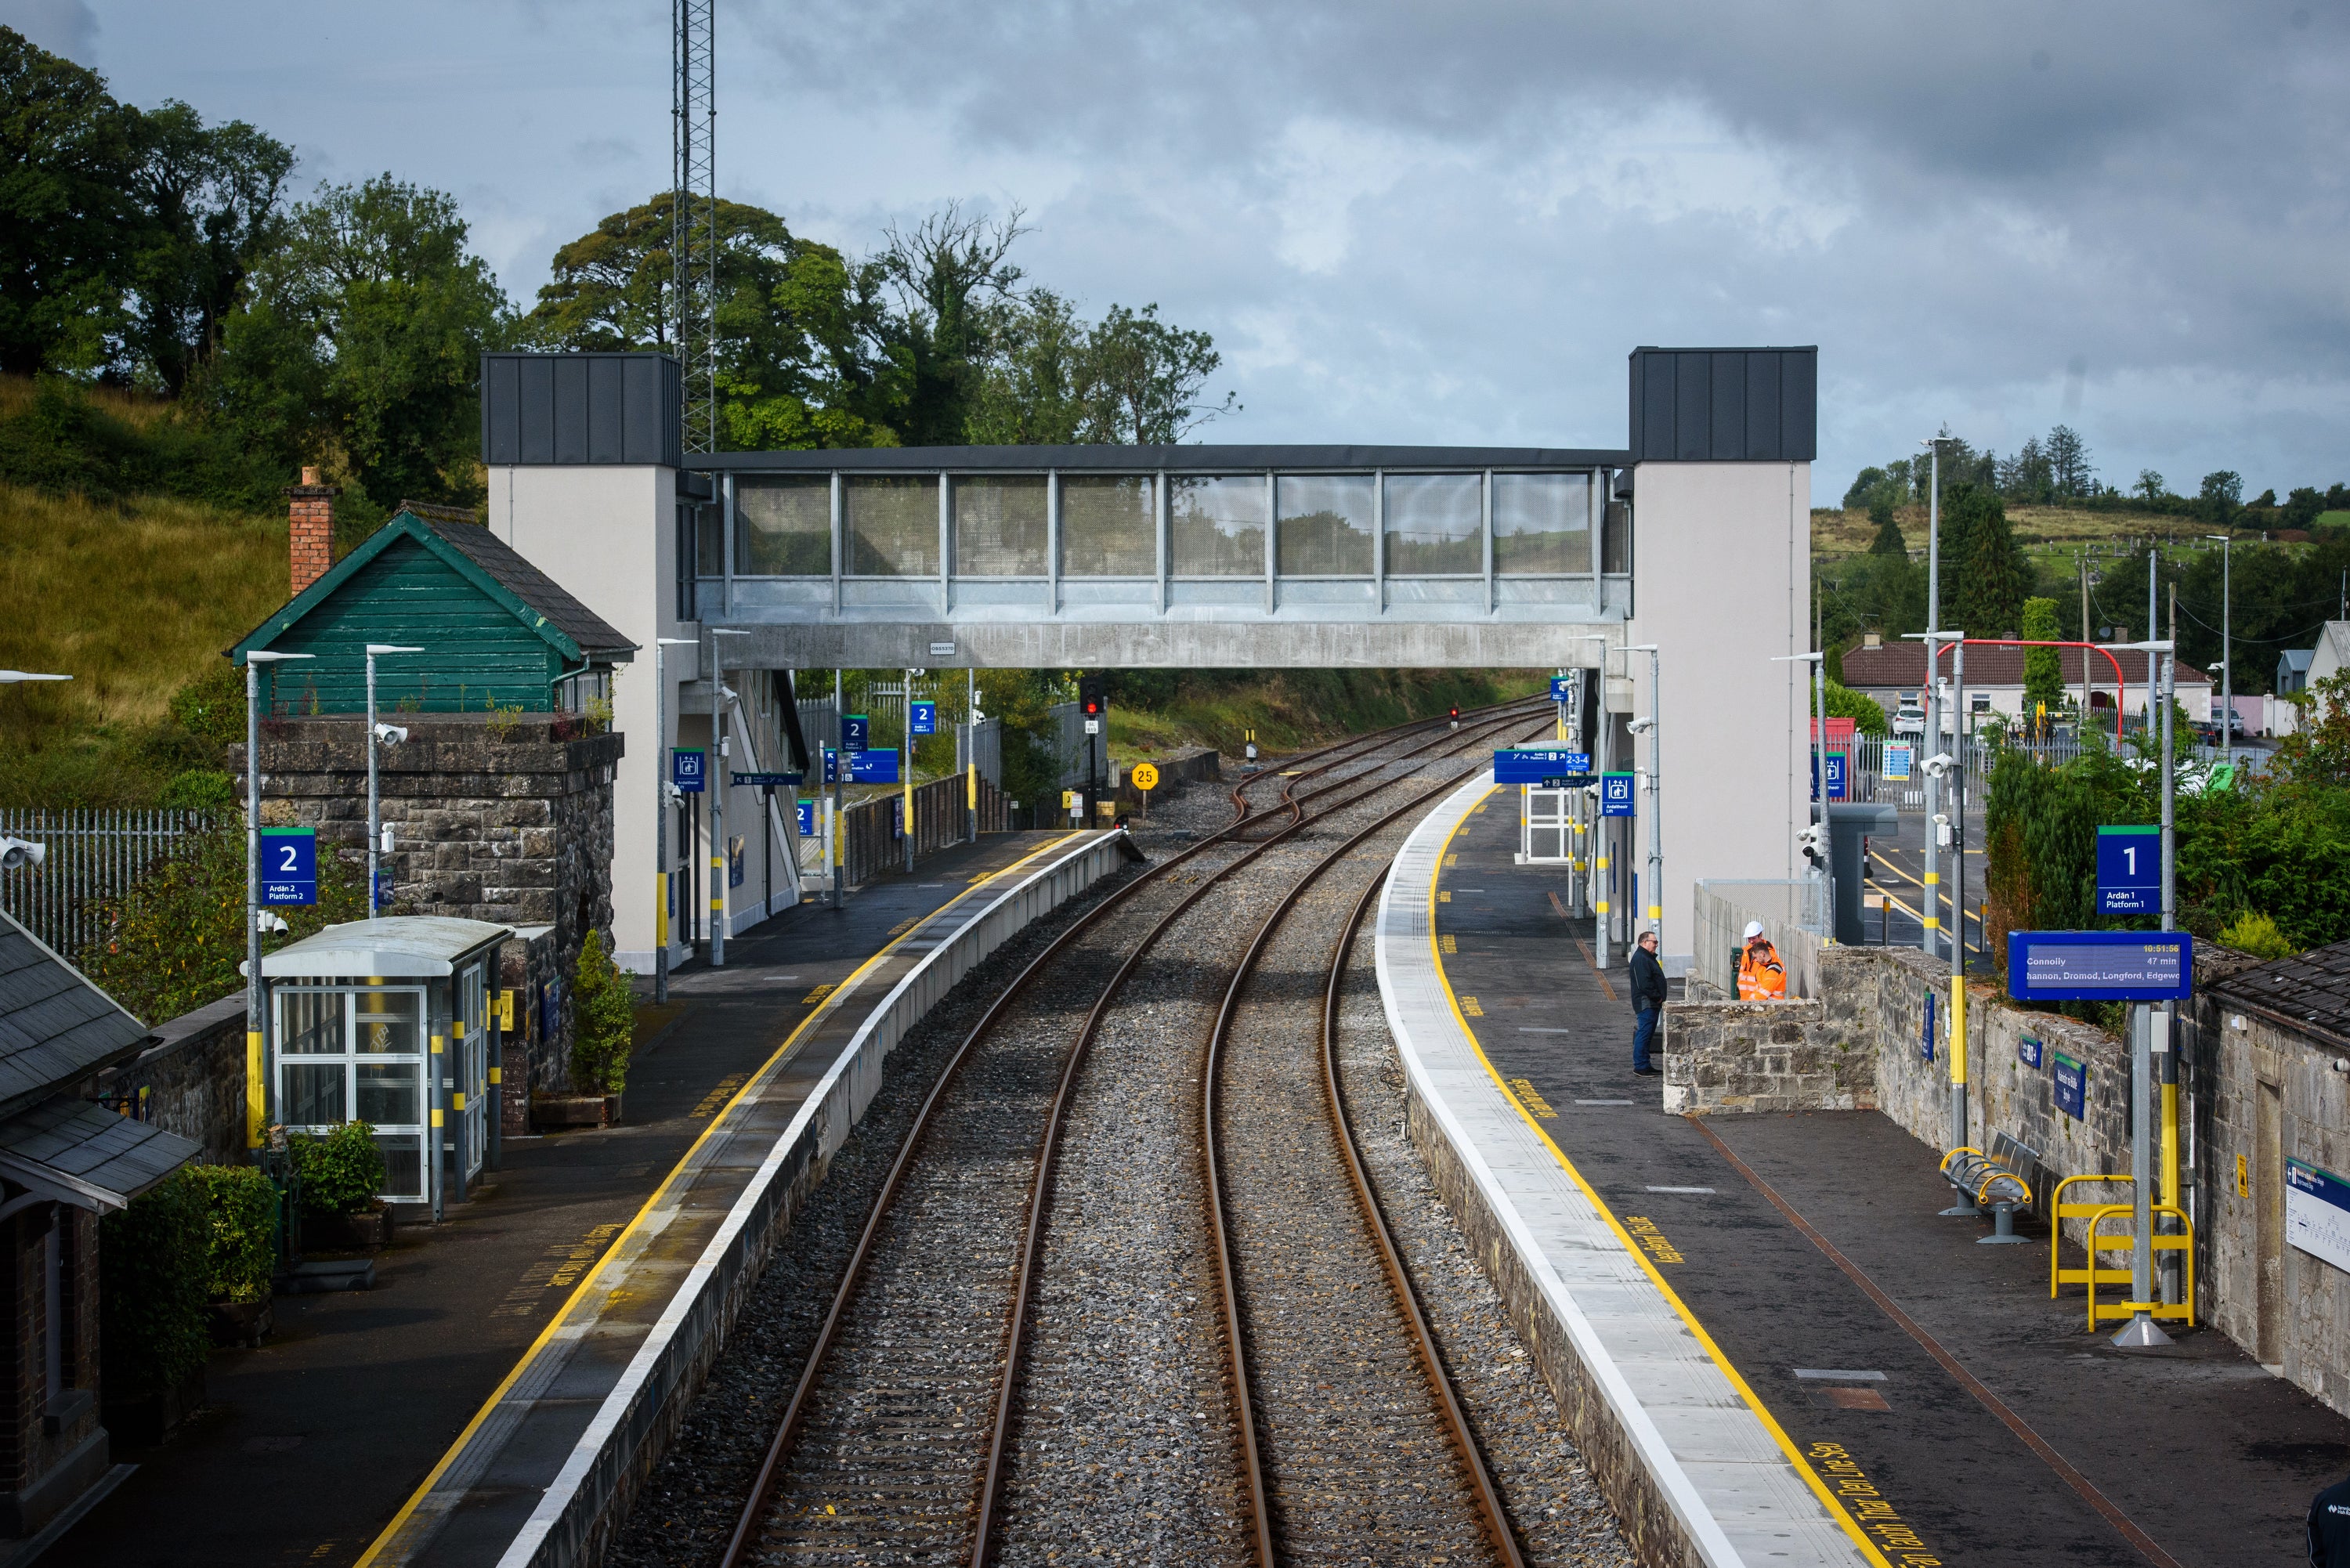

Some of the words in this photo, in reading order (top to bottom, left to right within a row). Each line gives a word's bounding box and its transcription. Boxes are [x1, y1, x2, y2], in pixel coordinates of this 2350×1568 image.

[919, 708, 927, 721] 2
[850, 723, 859, 736] 2
[1567, 755, 1589, 764] 2-3-4
[1138, 771, 1152, 782] 25
[797, 807, 804, 821] 2
[280, 845, 298, 871] 2
[2123, 847, 2135, 876] 1
[2106, 900, 2139, 909] Platform
[2026, 957, 2066, 967] Connolly
[2147, 957, 2157, 966] 47
[2063, 972, 2101, 981] Dromod,
[2102, 972, 2145, 981] Longford,
[1622, 1216, 1654, 1226] Line
[1629, 1225, 1661, 1235] This
[1653, 1251, 1686, 1263] Keep
[1808, 1442, 1849, 1458] Seo
[1837, 1479, 1881, 1497] Den
[1851, 1498, 1901, 1521] Thiar
[1867, 1523, 1928, 1552] Taobh
